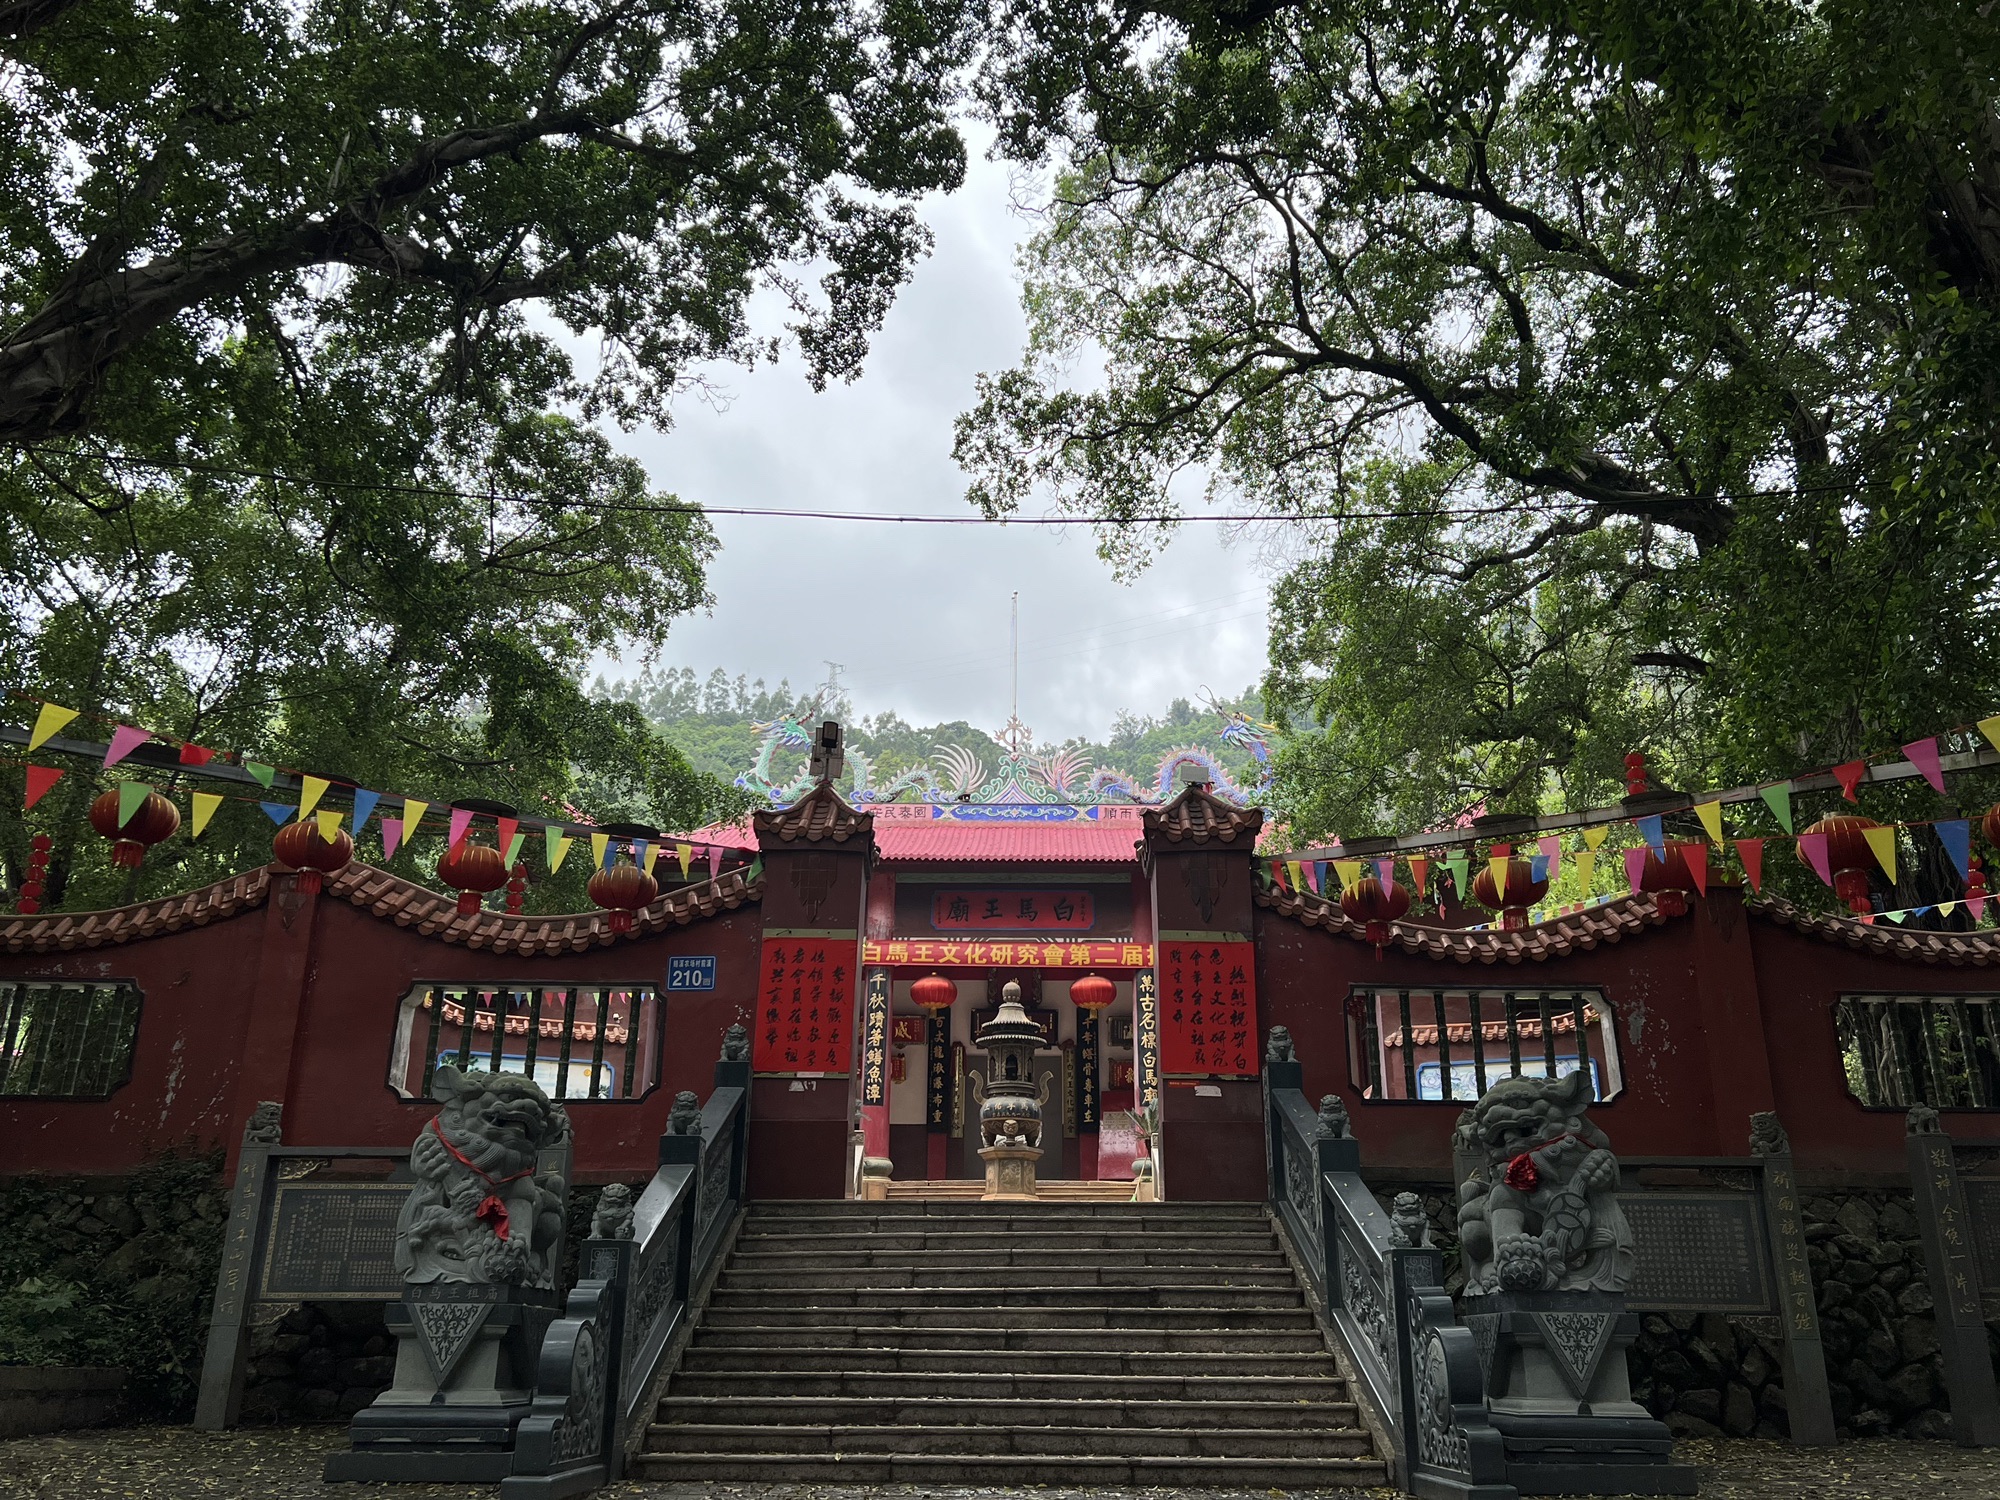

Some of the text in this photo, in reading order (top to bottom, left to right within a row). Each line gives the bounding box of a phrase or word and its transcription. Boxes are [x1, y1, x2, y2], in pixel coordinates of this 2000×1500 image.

[946, 896, 1075, 922] 白馬王廟
[672, 969, 702, 986] 210
[411, 1286, 498, 1301] 白马王祖庙
